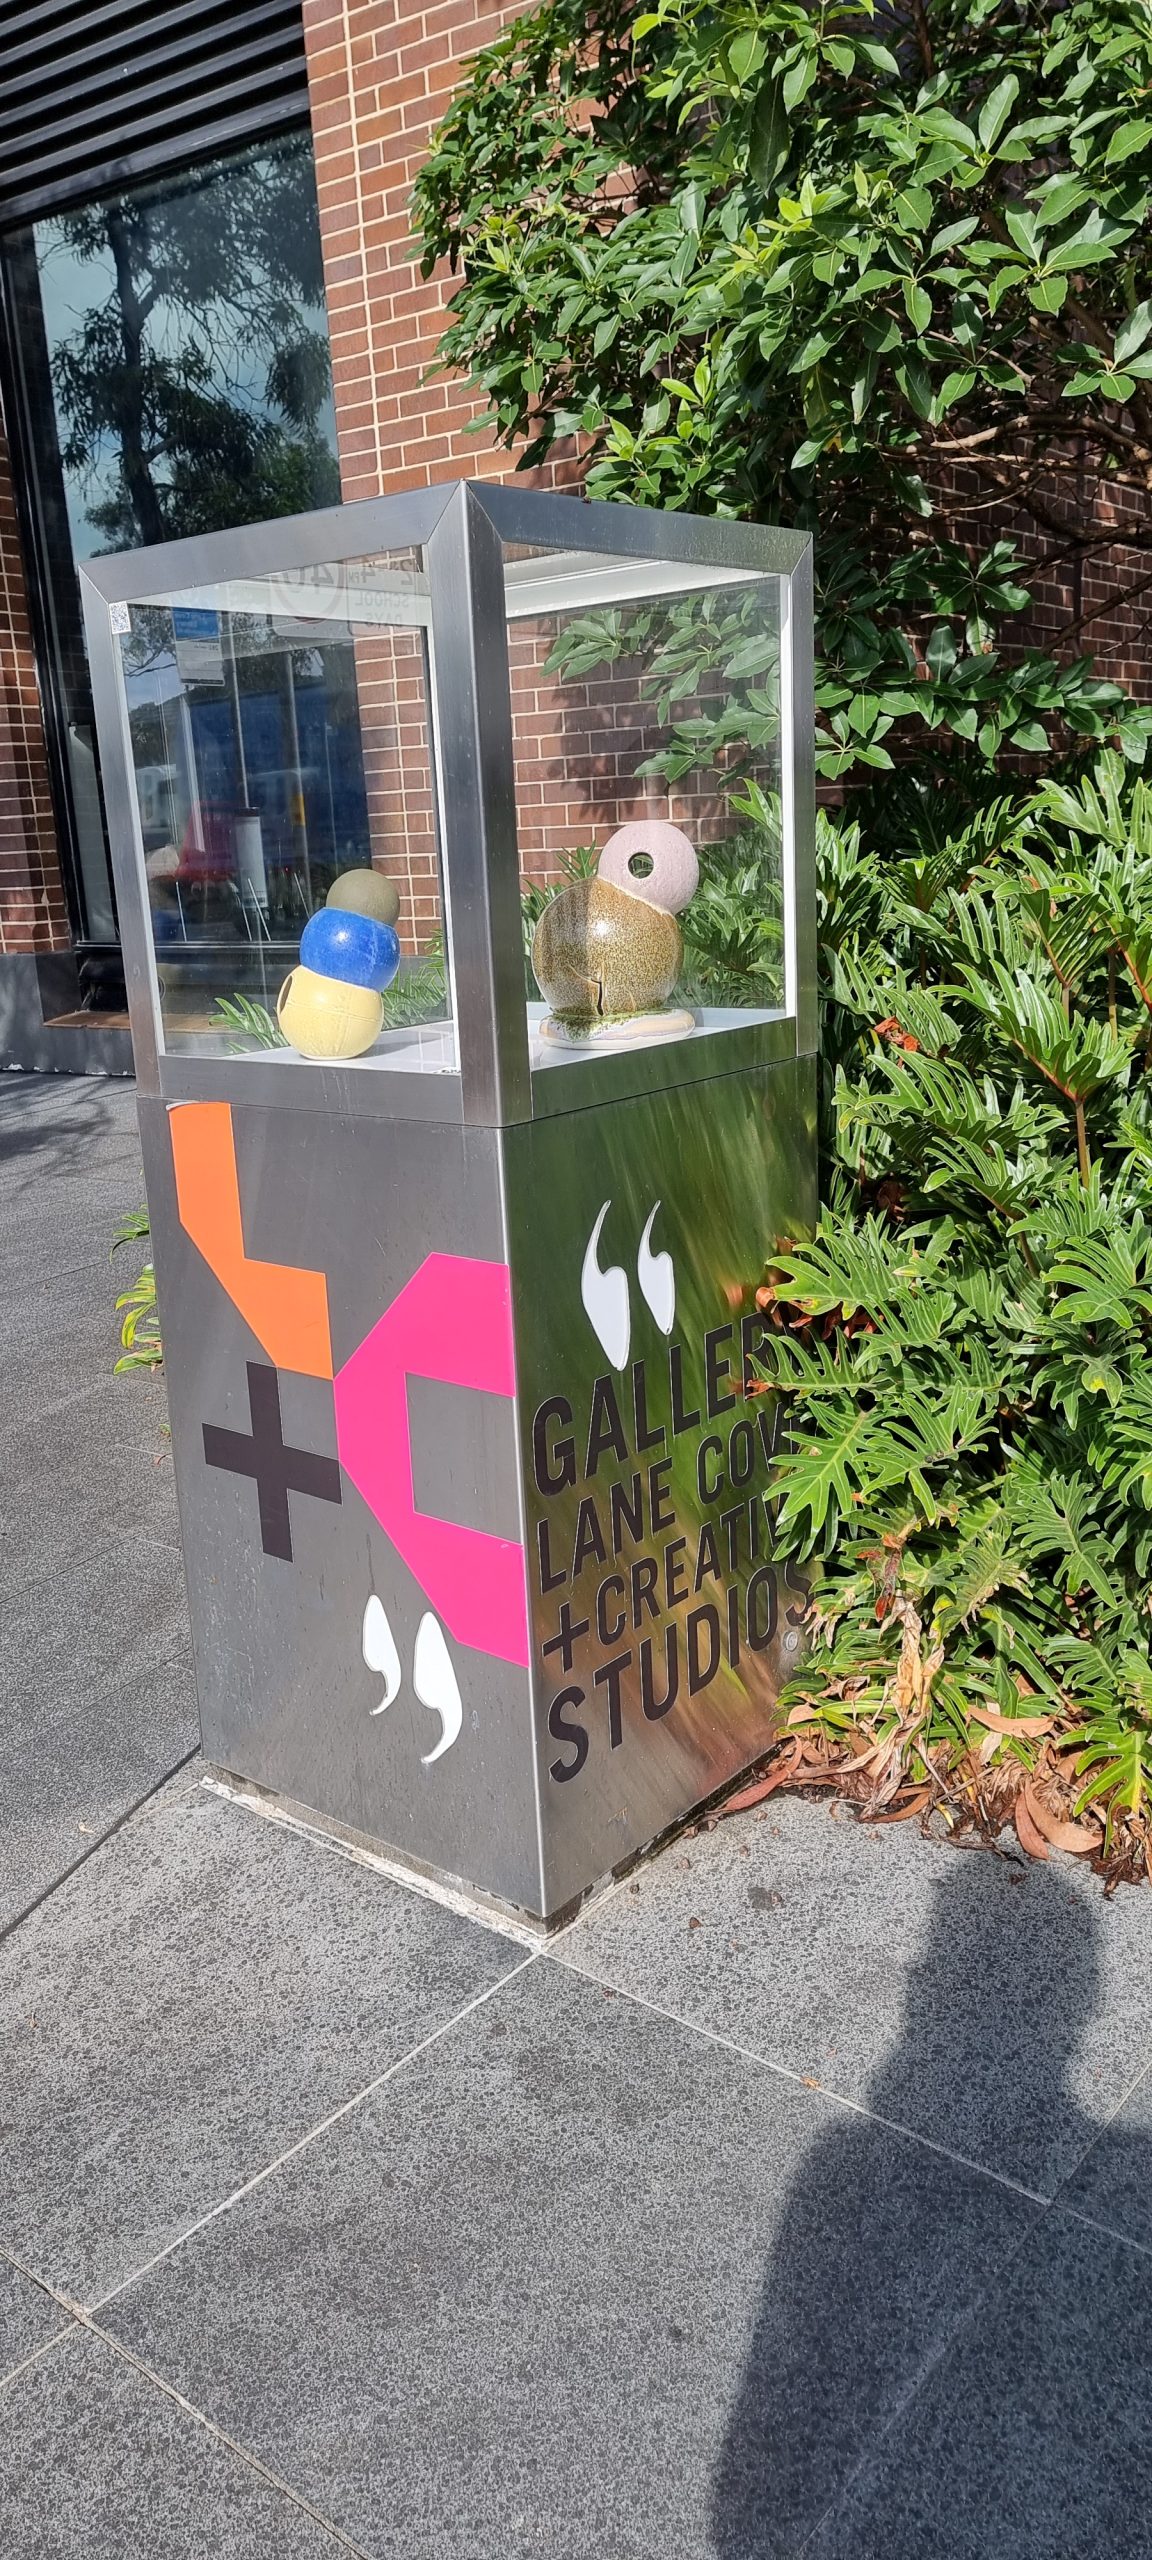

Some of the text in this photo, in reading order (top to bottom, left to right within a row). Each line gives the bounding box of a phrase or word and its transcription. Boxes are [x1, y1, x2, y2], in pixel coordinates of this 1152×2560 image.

[532, 1310, 795, 1497] GALLER
[538, 1458, 676, 1595] LANE
[547, 1556, 815, 1784] STUDIOS
